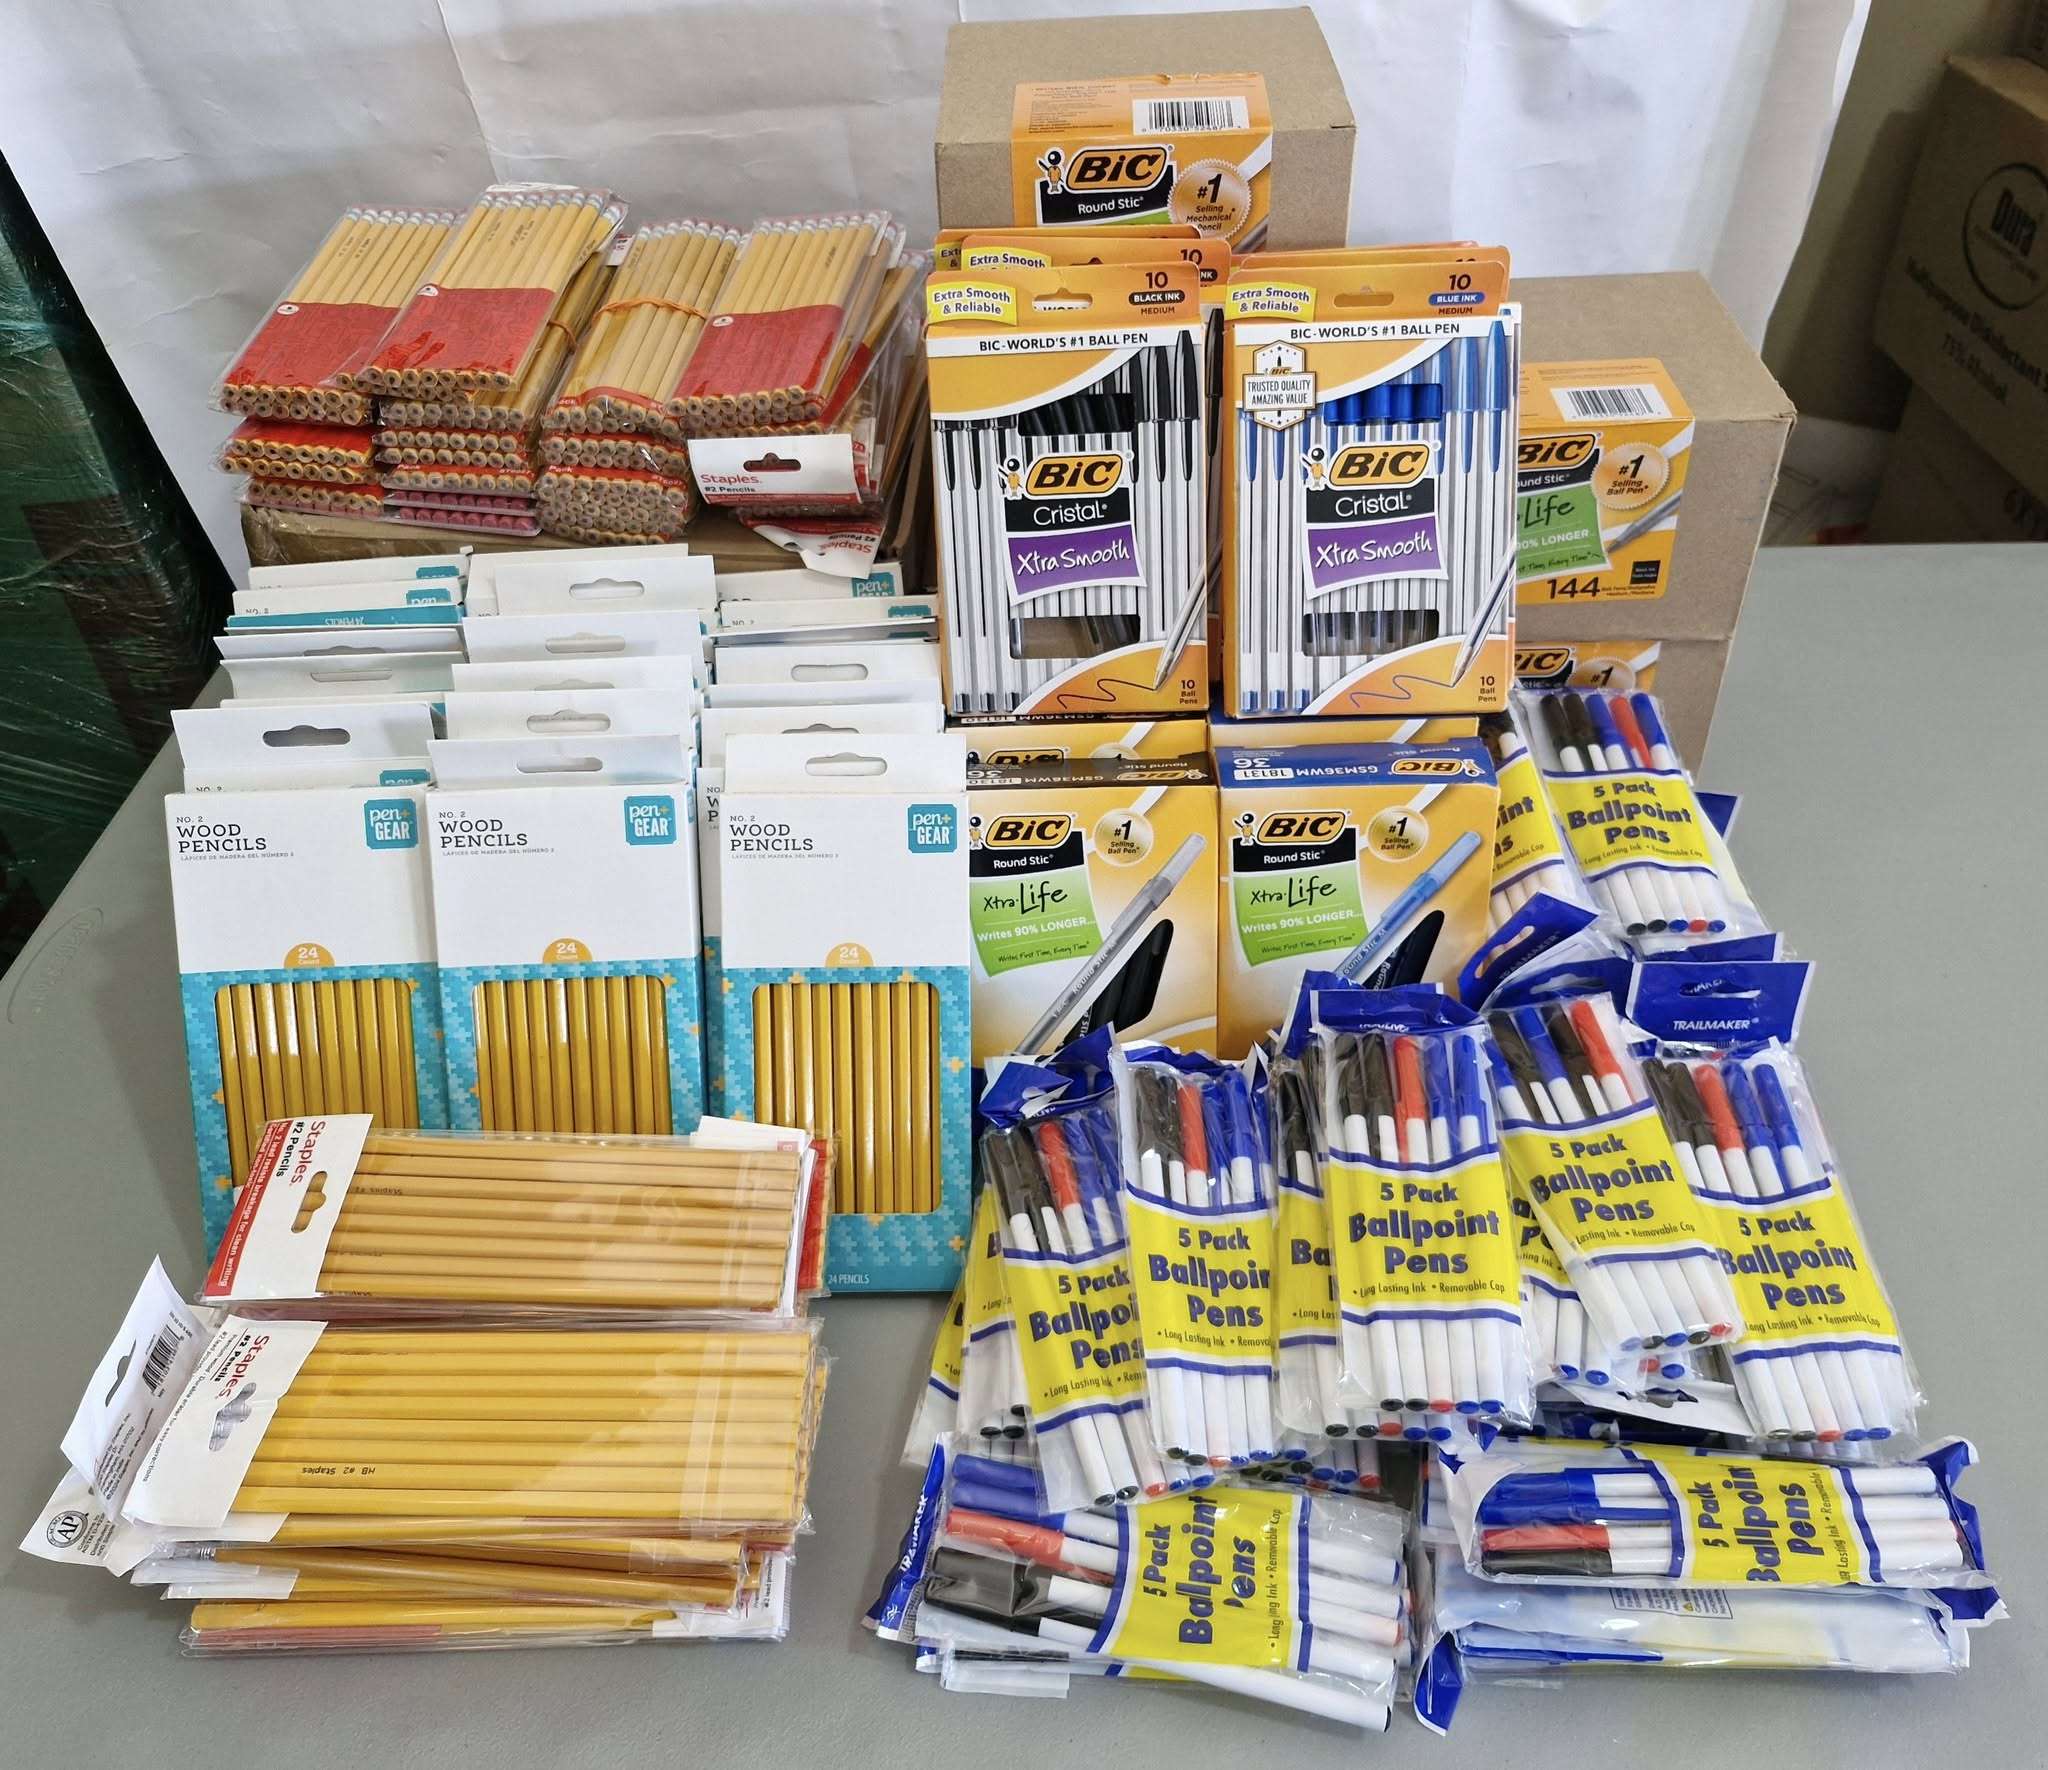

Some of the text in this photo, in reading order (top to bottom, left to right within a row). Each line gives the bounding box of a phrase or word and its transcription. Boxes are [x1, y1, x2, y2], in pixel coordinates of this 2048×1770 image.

[1197, 174, 1222, 204] #1
[1078, 198, 1140, 214] Round Stic
[1196, 205, 1223, 214] Selling
[1186, 214, 1231, 224] Mechanical
[970, 253, 1045, 267] Extra Smooth
[1145, 272, 1168, 288] 10
[1448, 274, 1471, 290] 10
[934, 288, 1010, 303] Extra Smooth
[1133, 292, 1179, 303] BLACK INK
[1232, 287, 1310, 303] Extra Smooth
[1437, 294, 1477, 303] BLUE INK
[943, 302, 1001, 315] & Reliable
[1140, 305, 1175, 315] MEDIUM
[1240, 300, 1299, 314] & Reliable
[1438, 305, 1472, 315] MEDIUM
[1382, 323, 1460, 337] #1 BALL PEN
[1070, 333, 1148, 347] #1 BALL PEN
[1247, 380, 1310, 392] TRUSTED QUALITY
[1252, 394, 1308, 406] AMAZING VALUE
[1619, 455, 1644, 478] #1
[701, 473, 759, 485] Staples
[1612, 479, 1642, 488] Selling
[1607, 486, 1627, 495] Ball
[1336, 491, 1408, 518] Cristal
[1033, 500, 1104, 526] Cristal
[1360, 530, 1432, 560] Smooth
[1541, 529, 1589, 546] LONGER
[1060, 538, 1130, 567] Smooth
[1547, 577, 1600, 599] 144
[1180, 679, 1195, 689] 10
[1480, 676, 1495, 686] 10
[1590, 667, 1613, 686] #1
[1181, 690, 1195, 698] Ball
[1478, 695, 1497, 703] Pens
[1480, 687, 1495, 695] Ball
[1179, 697, 1198, 705] Pens
[1149, 761, 1188, 769] Round
[1234, 758, 1271, 769] 36
[1243, 766, 1379, 778] GSM36WM 18131
[1593, 782, 1657, 798] 5 Pack
[198, 814, 204, 822] 2
[461, 809, 467, 818] 2
[751, 814, 757, 822] 2
[1567, 799, 1692, 831] Ballpoint
[177, 823, 241, 838] WOOD
[375, 820, 410, 839] GEAR
[440, 818, 503, 833] WOOD
[634, 819, 669, 838] GEAR
[731, 823, 790, 837] WOOD
[1114, 820, 1132, 840] #1
[1388, 817, 1409, 837] #1
[441, 833, 529, 849] PENCILS
[917, 826, 950, 844] GEAR
[1384, 837, 1409, 846] Selling
[1604, 825, 1671, 846] Pens
[179, 837, 267, 853] PENCILS
[731, 837, 814, 851] PENCILS
[1111, 841, 1134, 849] Selling
[994, 855, 1050, 869] Round Stic
[1264, 850, 1320, 864] Round Stic
[977, 916, 1087, 942] Writes 90% LONGER
[1241, 909, 1353, 934] Writes 90% LONGER
[299, 946, 317, 958] 24
[557, 942, 577, 953] 24
[840, 946, 859, 958] 24
[1672, 1020, 1751, 1032] TRAILMAKER
[276, 1121, 305, 1177] #2 Pencils
[290, 1120, 327, 1185] Staples
[1552, 1134, 1628, 1159] 5 Pack
[1529, 1157, 1676, 1204] Ballpoint
[1380, 1183, 1458, 1203] 5 Pack
[1570, 1197, 1655, 1223] Pens
[1349, 1209, 1500, 1248] Ballpoint
[1632, 1221, 1696, 1239] Removable Cap
[1738, 1211, 1816, 1236] 5 Pack
[230, 1233, 243, 1256] clean
[1178, 1227, 1250, 1250] 5 Pack
[1384, 1247, 1469, 1276] Pens
[1715, 1239, 1857, 1280] Ballpoint
[1059, 1274, 1072, 1294] 5
[1378, 1280, 1505, 1297] Lasting Ink Removable Cap
[1760, 1282, 1846, 1311] Pens
[1187, 1293, 1264, 1327] Pens
[1165, 1327, 1209, 1345] Long Lasting
[214, 1350, 241, 1382] Pencils
[218, 1334, 269, 1398] Staples
[1049, 1382, 1069, 1399] Long
[1071, 1377, 1100, 1393] Lasting
[302, 1465, 376, 1476] Staples #2 HB
[1722, 1467, 1781, 1582] Ballpoin
[1779, 1483, 1825, 1556] Pens
[58, 1516, 82, 1542] AP
[1702, 1538, 1730, 1548] 5
[1142, 1523, 1171, 1598] 5 Pack
